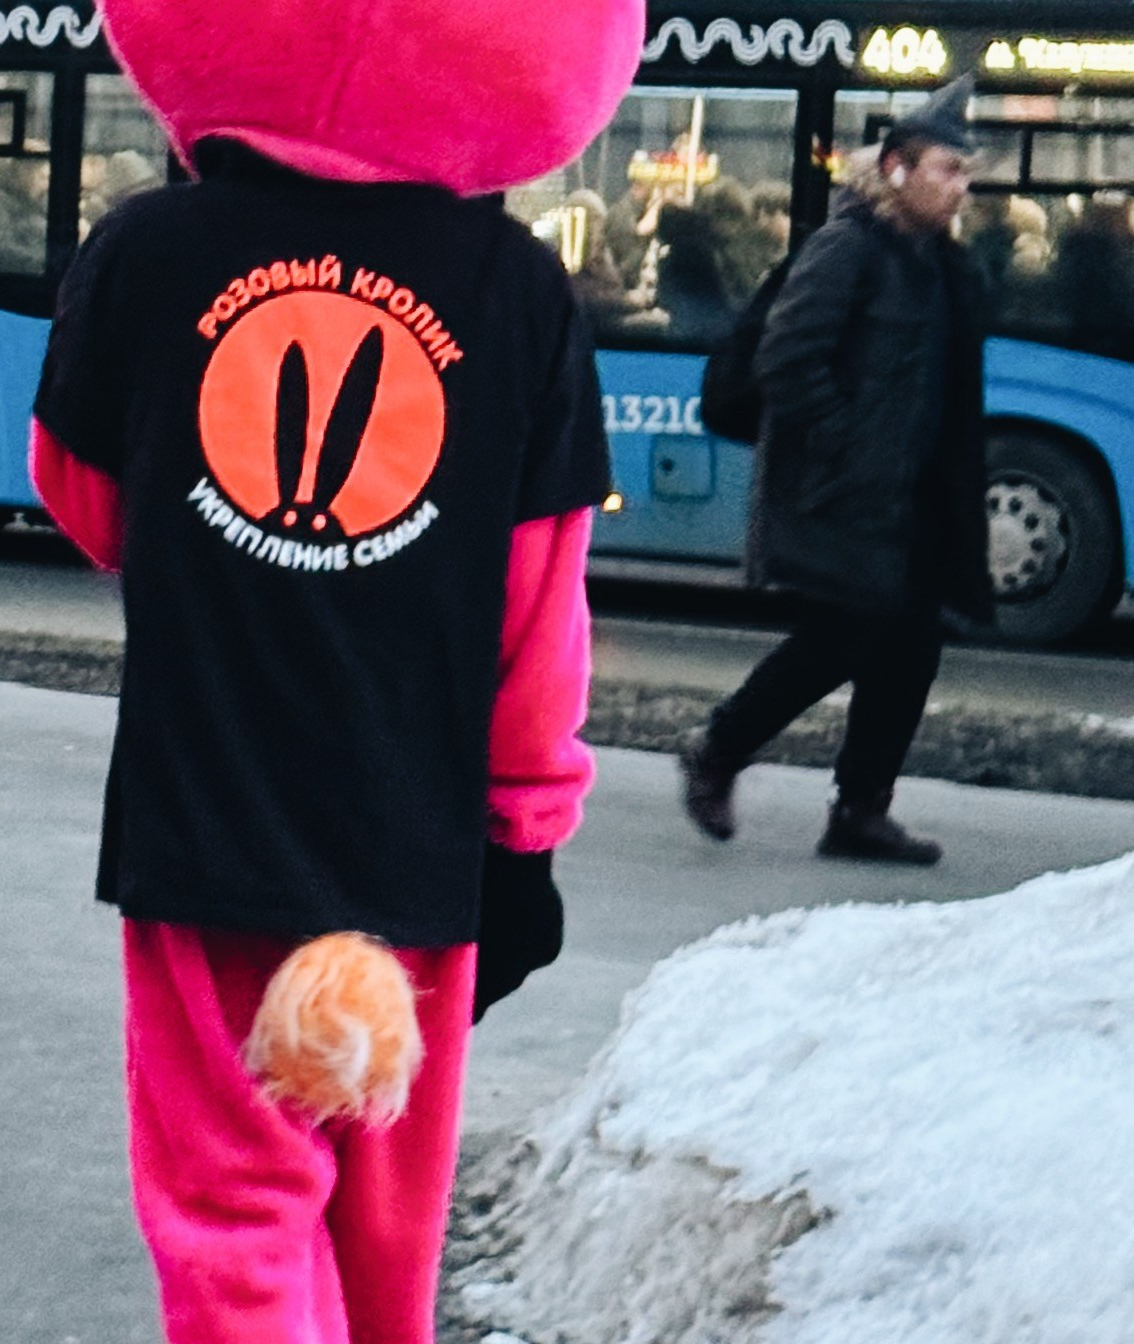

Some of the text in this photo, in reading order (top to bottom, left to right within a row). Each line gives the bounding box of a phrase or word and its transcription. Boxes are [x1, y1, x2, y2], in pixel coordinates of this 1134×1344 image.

[862, 27, 946, 73] 404
[197, 255, 464, 371] РОЗОВЫЙ КРОЛИК
[187, 476, 440, 571] УКРЕПЛЕНИЕ СЕМЬИ
